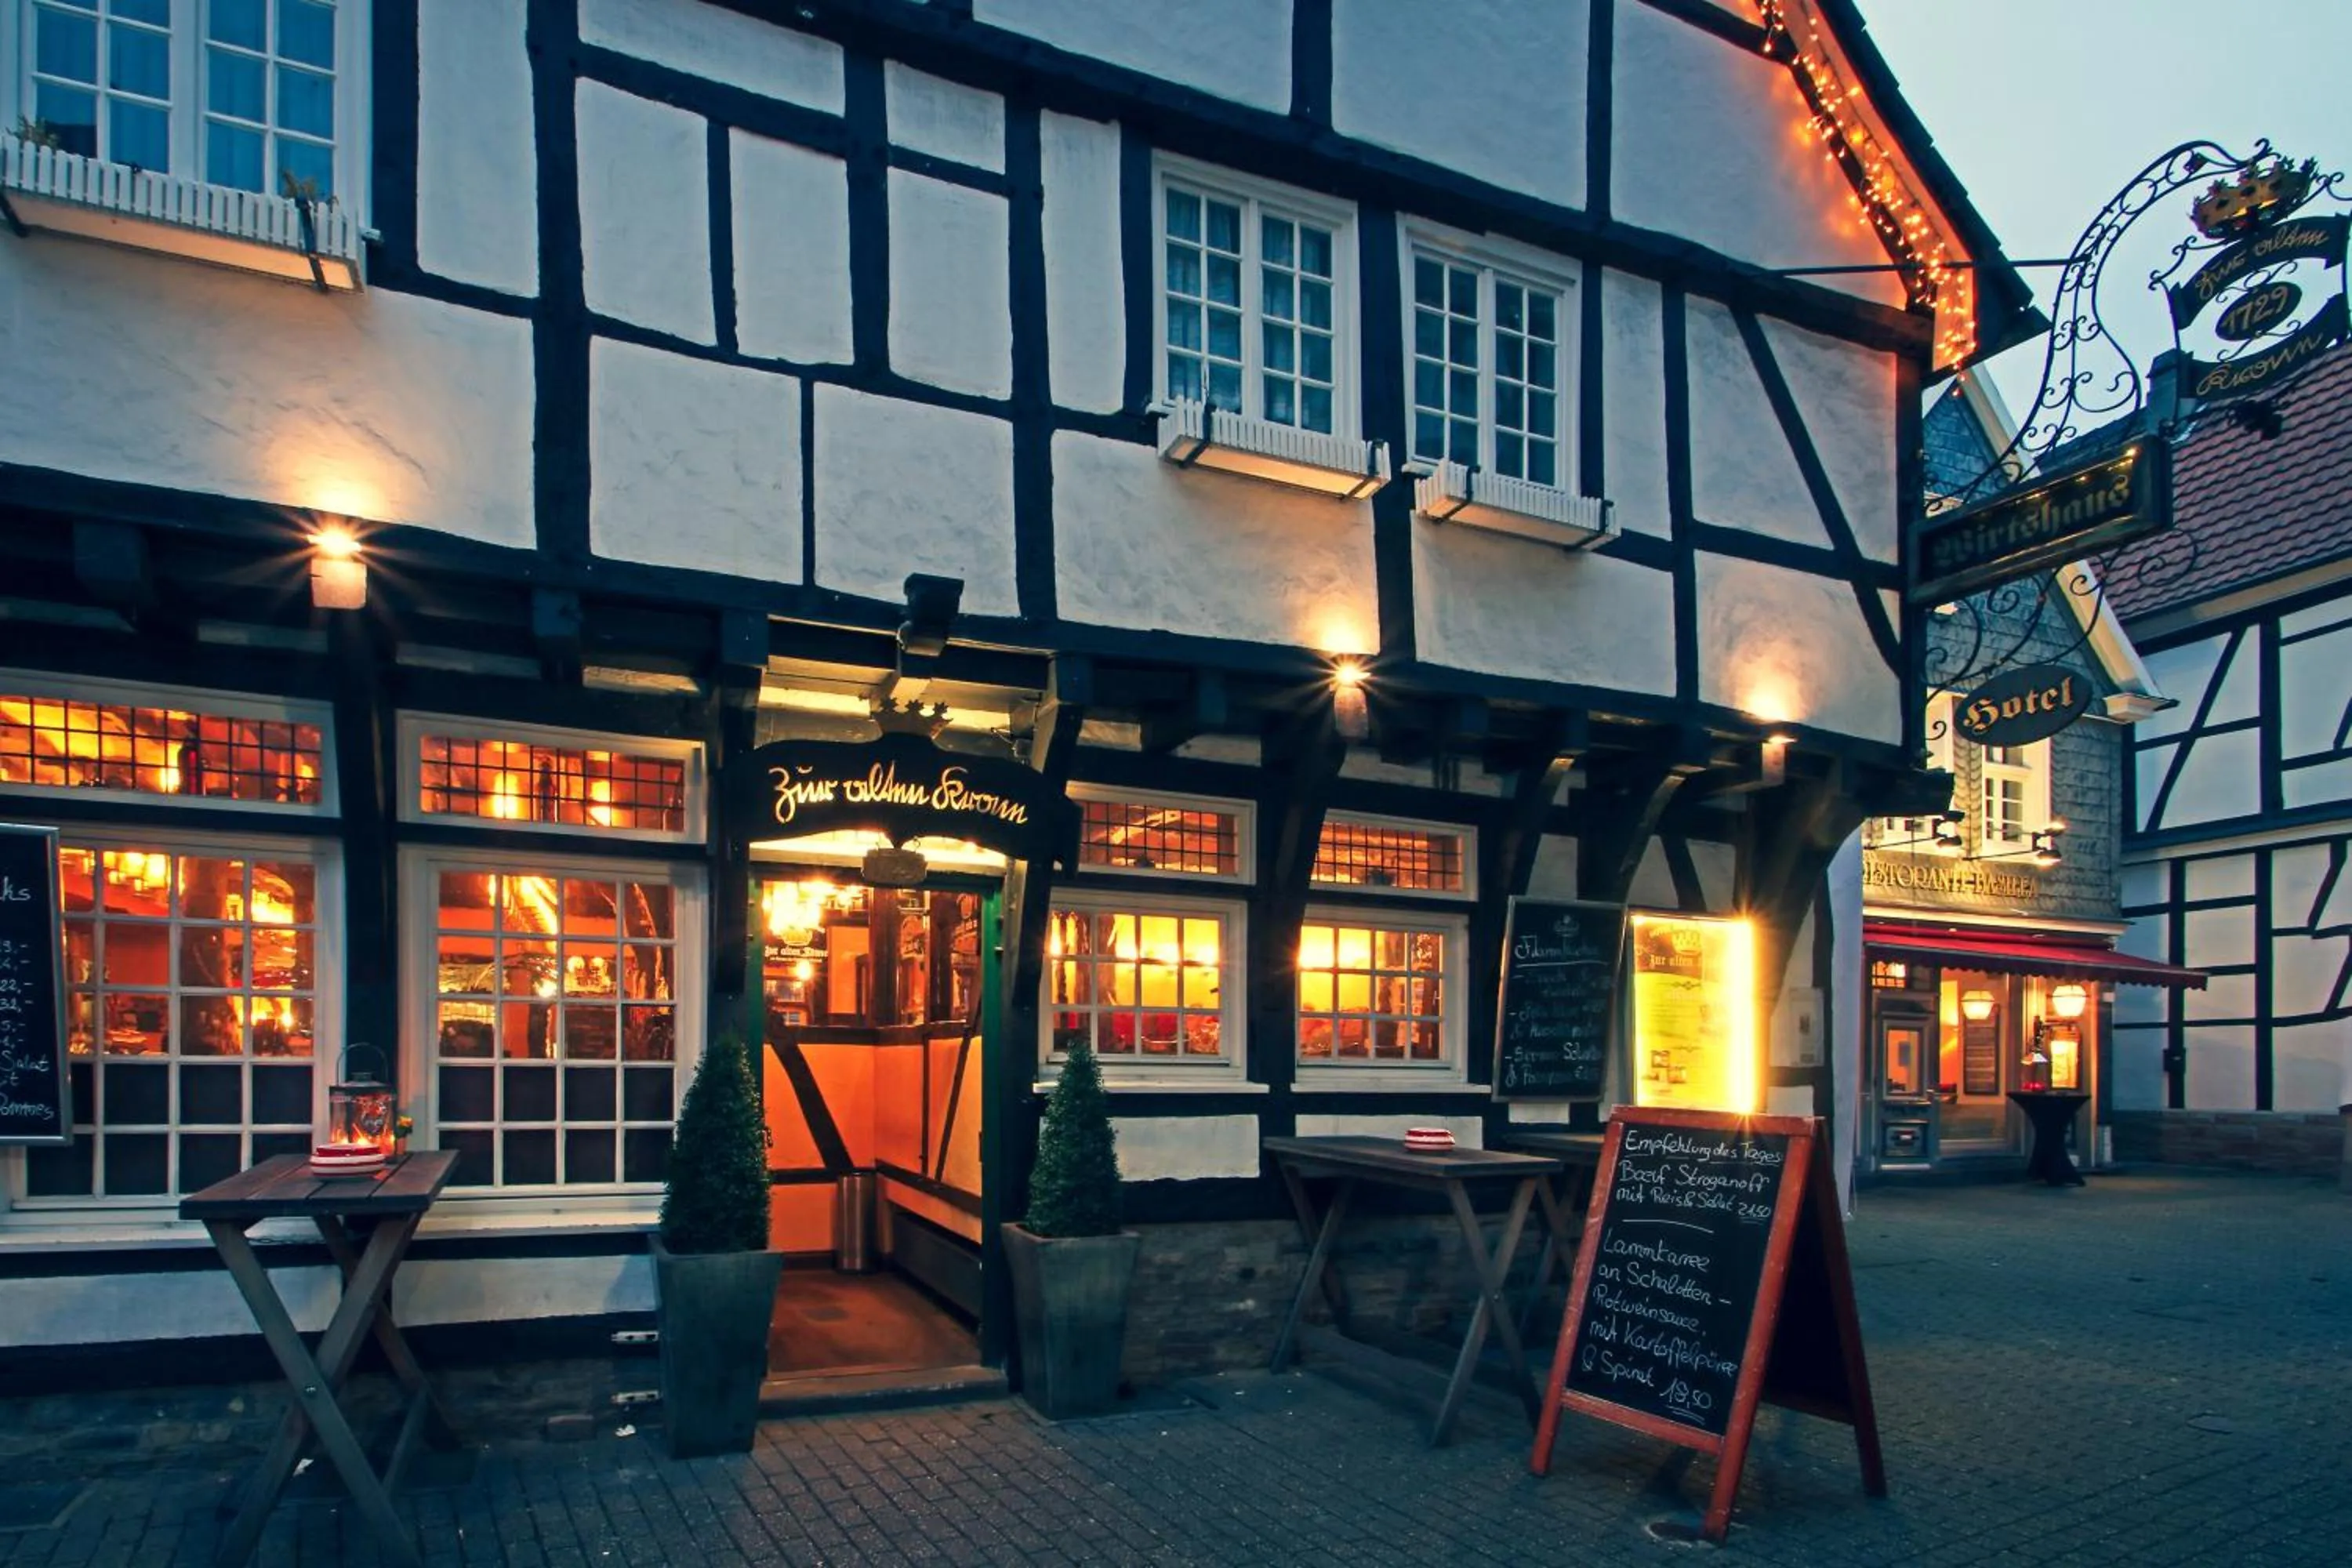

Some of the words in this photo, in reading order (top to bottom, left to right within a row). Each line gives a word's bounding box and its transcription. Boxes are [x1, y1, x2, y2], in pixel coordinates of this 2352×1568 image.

[2221, 284, 2289, 332] 1729
[1962, 676, 2074, 734] Hotel
[1863, 861, 1975, 892] ISTORANTE
[1624, 1129, 1711, 1163] Empfehlung
[1712, 1142, 1738, 1159] des
[1739, 1141, 1783, 1165] Tages
[1615, 1182, 1646, 1204] mit
[1675, 1163, 1770, 1192] Stroganoff
[1598, 1264, 1621, 1282] an
[1589, 1315, 1618, 1343] mit
[1581, 1344, 1597, 1372] &
[1601, 1350, 1654, 1388] Spinat
